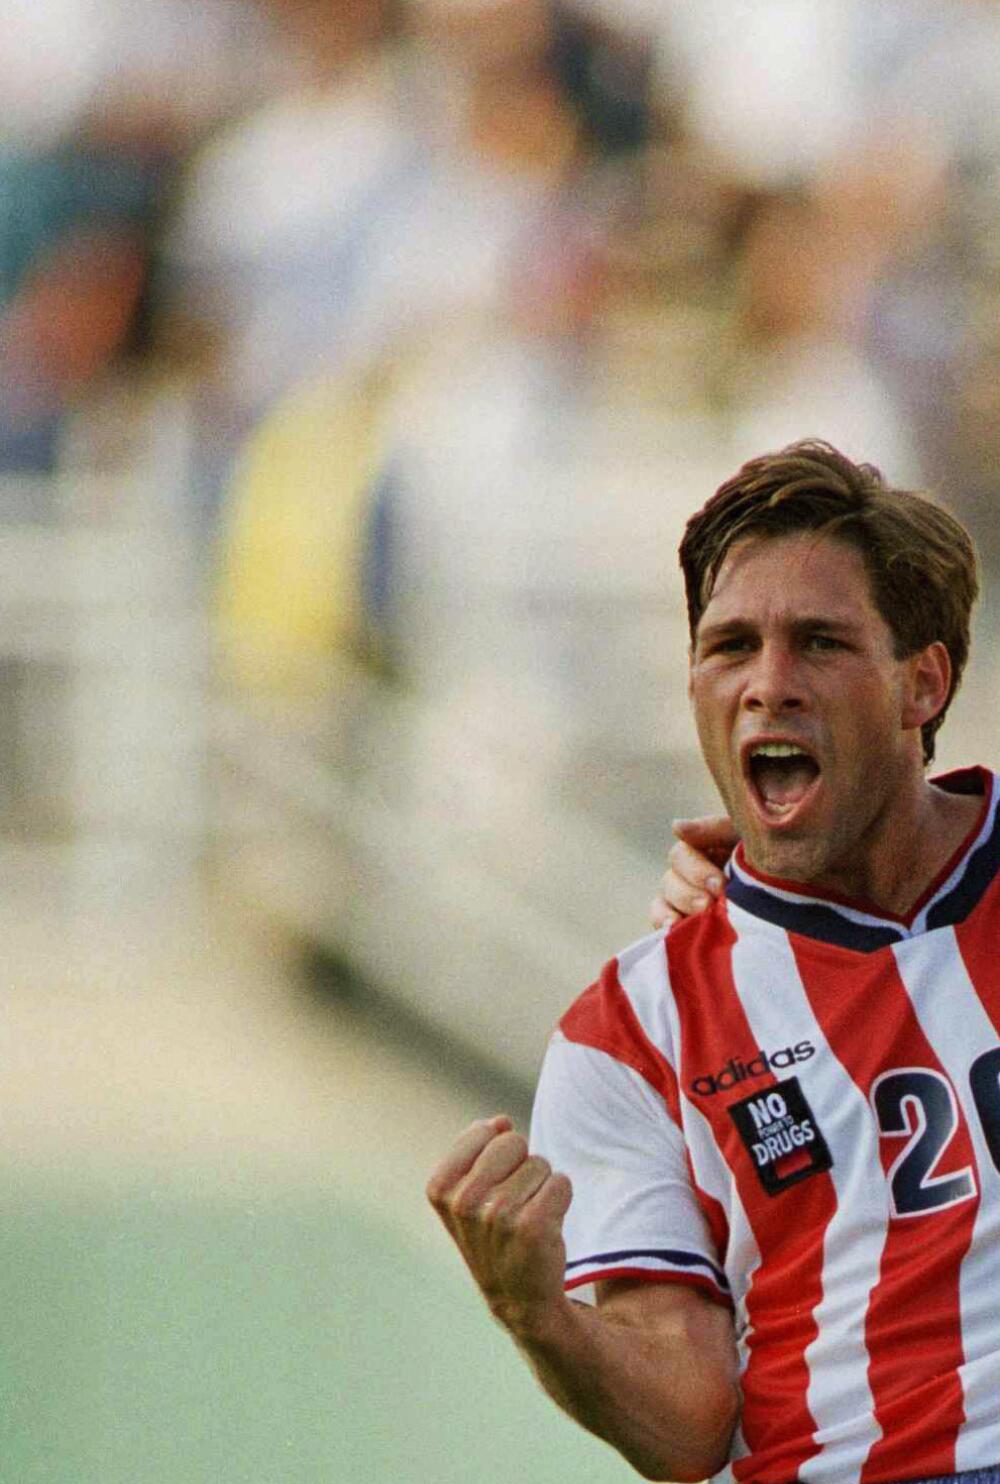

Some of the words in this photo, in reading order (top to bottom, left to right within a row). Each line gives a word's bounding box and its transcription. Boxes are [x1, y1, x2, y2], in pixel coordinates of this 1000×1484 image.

[691, 1040, 816, 1096] adidas
[747, 1092, 788, 1130] NO
[751, 1119, 815, 1167] DRUGS
